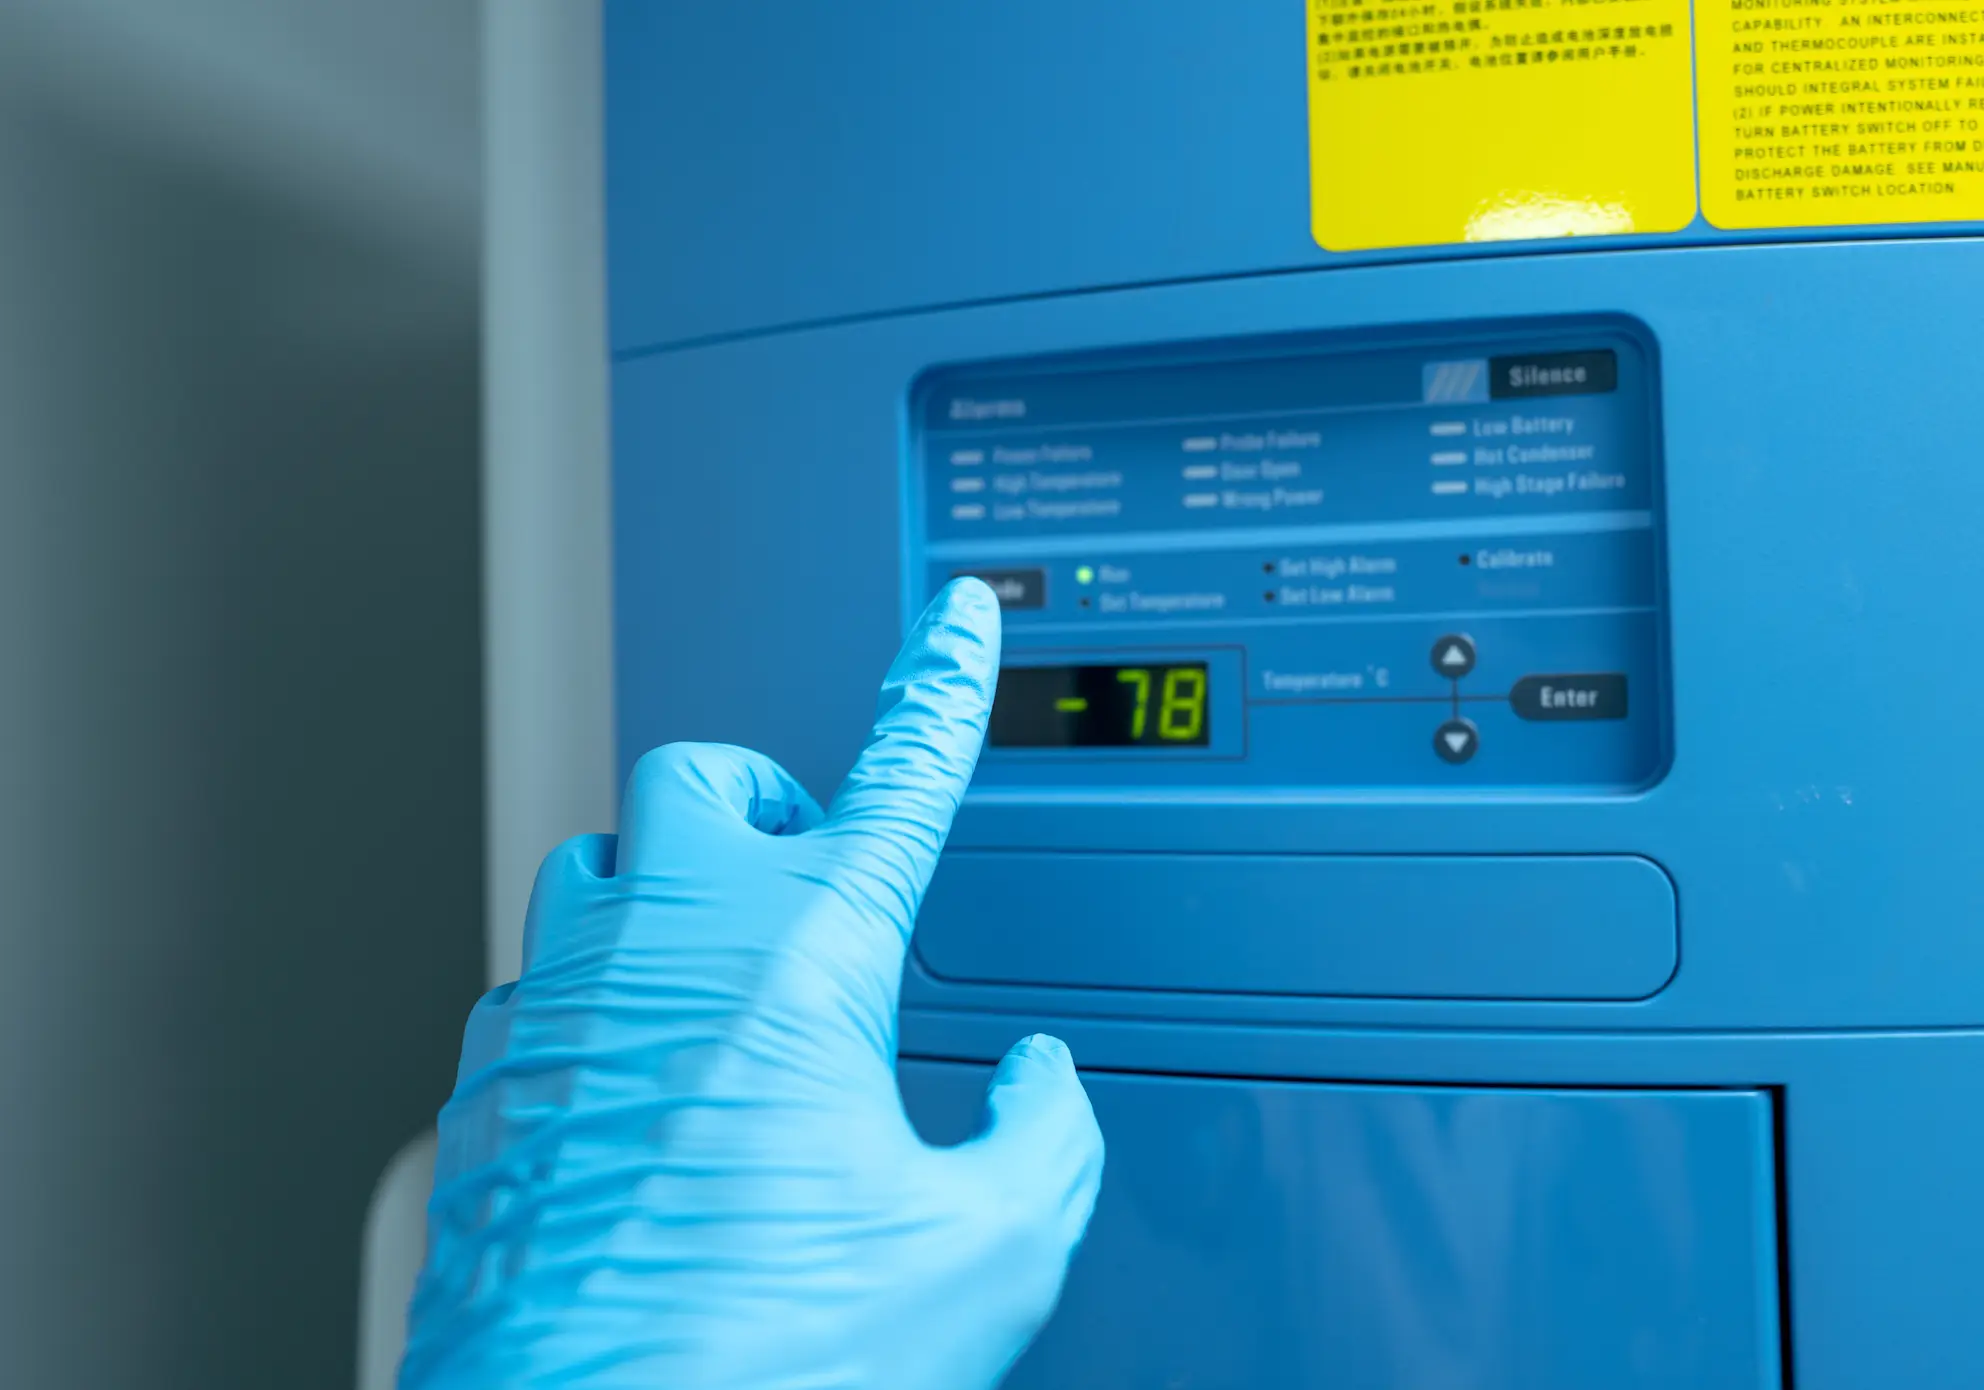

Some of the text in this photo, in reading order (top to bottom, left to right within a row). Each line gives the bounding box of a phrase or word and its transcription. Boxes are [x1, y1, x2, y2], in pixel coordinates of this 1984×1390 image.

[1840, 16, 1861, 27] AN
[1733, 41, 1764, 53] AND
[1771, 35, 1898, 52] THERMOCOUPLE
[1905, 34, 1936, 47] ARE
[1733, 54, 1984, 75] FOR CENTRALIZED MONITORING
[1734, 84, 1797, 98] SHOULD
[1803, 80, 1880, 95] INTEGRAL
[1887, 77, 1950, 92] SYSTEM
[1733, 107, 1752, 120] (2)
[1759, 106, 1773, 118] IF
[1780, 103, 1835, 117] POWER
[1841, 99, 1960, 115] INTENTIONALLY
[1735, 119, 1978, 139] TURN BATTERY SWITCH OFF TO
[1735, 145, 1805, 160] PROTECT
[1813, 144, 1841, 157] THE
[1848, 142, 1917, 156] BATTERY
[1924, 141, 1967, 153] FROM
[1735, 165, 1825, 181] DISCHARGE
[1907, 162, 1936, 175] SEE
[1736, 182, 1956, 202] BATTERY SWITCH LOCATION
[1508, 365, 1587, 388] Silence
[1473, 416, 1574, 437] Low Battery
[1474, 444, 1595, 466] Hot Condenser
[1474, 471, 1626, 499] High Stage Failure
[1476, 549, 1554, 569] Calibrate
[1261, 670, 1363, 692] Temperature
[1539, 686, 1599, 708] Enter
